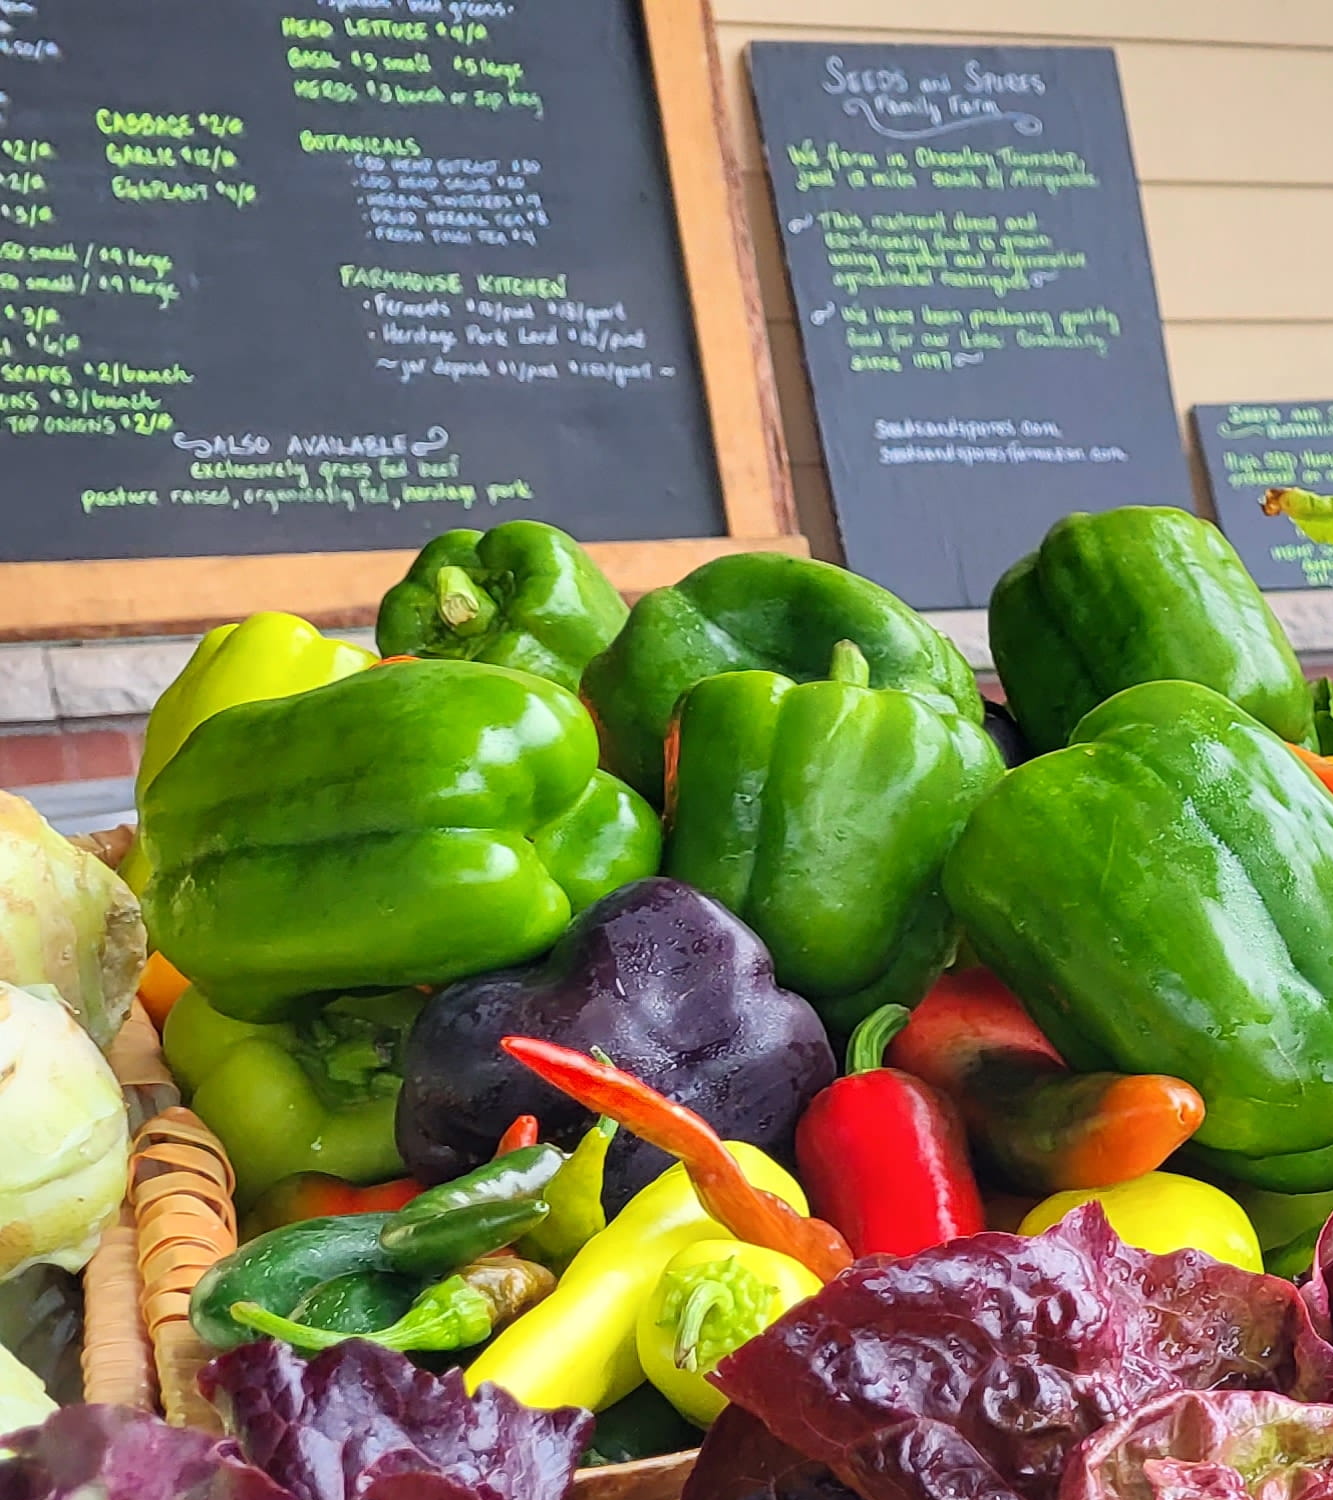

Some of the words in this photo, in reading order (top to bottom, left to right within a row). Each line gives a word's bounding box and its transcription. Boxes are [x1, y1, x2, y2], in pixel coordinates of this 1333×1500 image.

[281, 17, 334, 39] HEAD
[344, 17, 428, 41] LETTUCE
[382, 52, 432, 73] small
[480, 56, 524, 88] large
[95, 108, 194, 139] CABBAGE
[106, 142, 177, 168] GARLIC
[299, 129, 422, 156] BOTANICALS
[827, 141, 877, 171] farm
[112, 175, 208, 201] EGGPLANT
[28, 242, 77, 261] small
[127, 248, 173, 279] large
[26, 274, 76, 292] small
[129, 274, 181, 310] large
[339, 265, 463, 295] FARMHOUSE
[476, 273, 567, 299] KITCHEN
[382, 321, 458, 353] Heritage
[464, 324, 508, 347] Pork
[1, 362, 72, 386] SCAPES
[212, 434, 270, 456] ALSO
[287, 435, 408, 457] AVAILABLE
[190, 458, 308, 487] exclusively
[319, 461, 373, 487] grass
[418, 454, 460, 479] beef
[81, 486, 159, 513] pasture
[243, 485, 357, 514] organically
